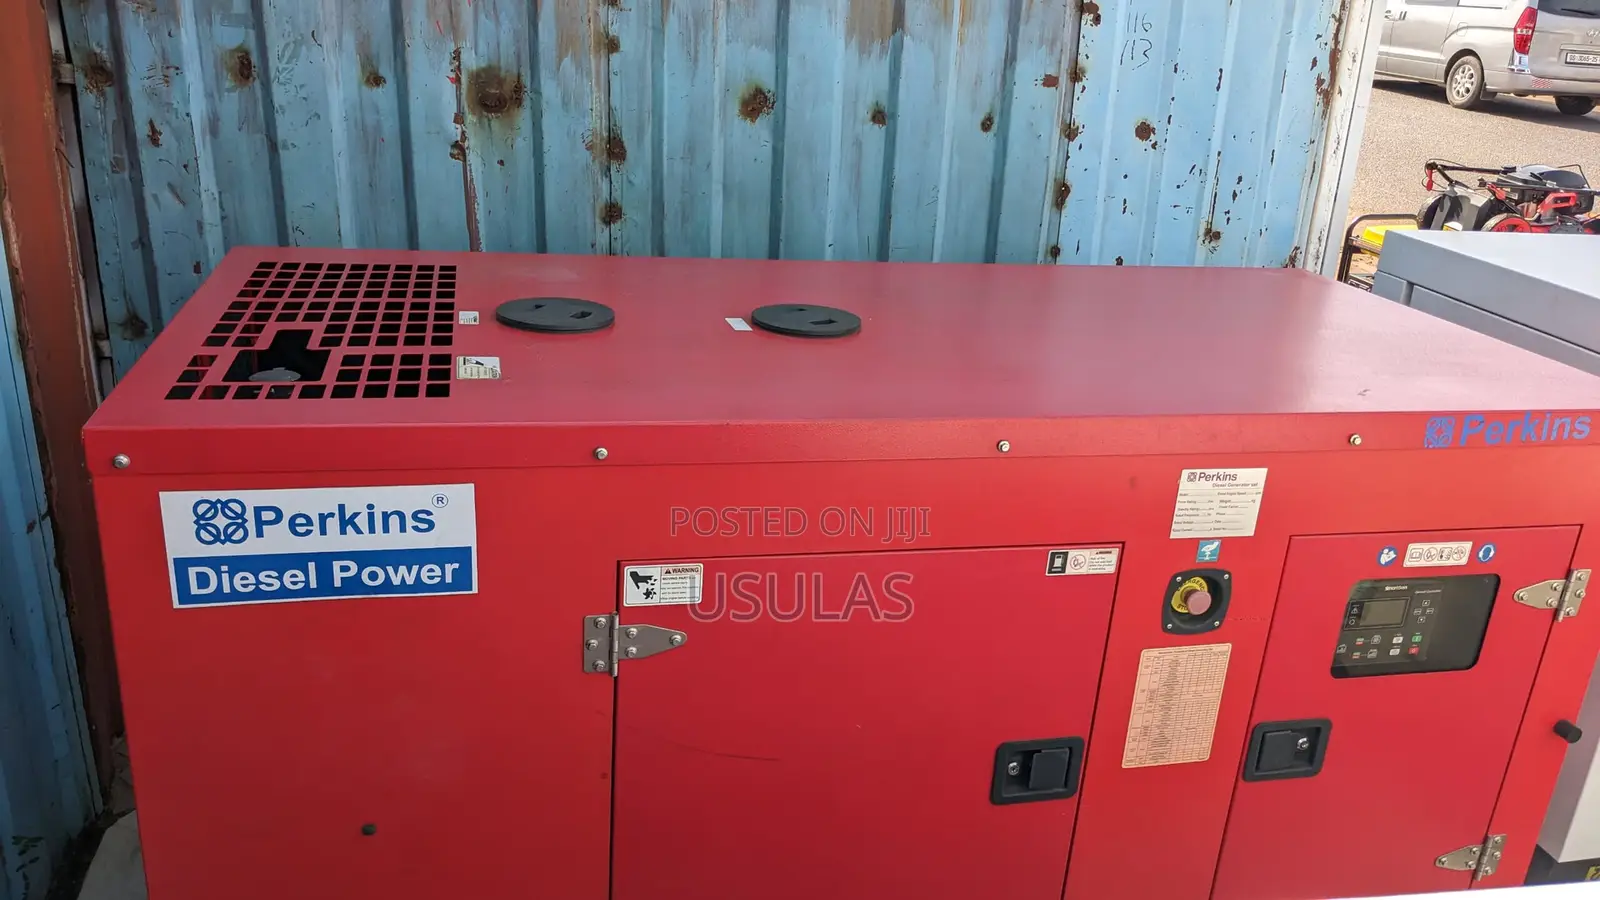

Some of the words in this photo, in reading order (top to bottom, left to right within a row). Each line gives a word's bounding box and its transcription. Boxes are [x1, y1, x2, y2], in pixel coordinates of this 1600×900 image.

[1127, 12, 1152, 32] 116
[1459, 410, 1592, 447] Perkins
[1198, 471, 1238, 482] Perkins
[253, 503, 436, 539] Perkins
[187, 562, 317, 596] Diesel
[331, 560, 460, 588] Power
[1176, 603, 1189, 611] STO
